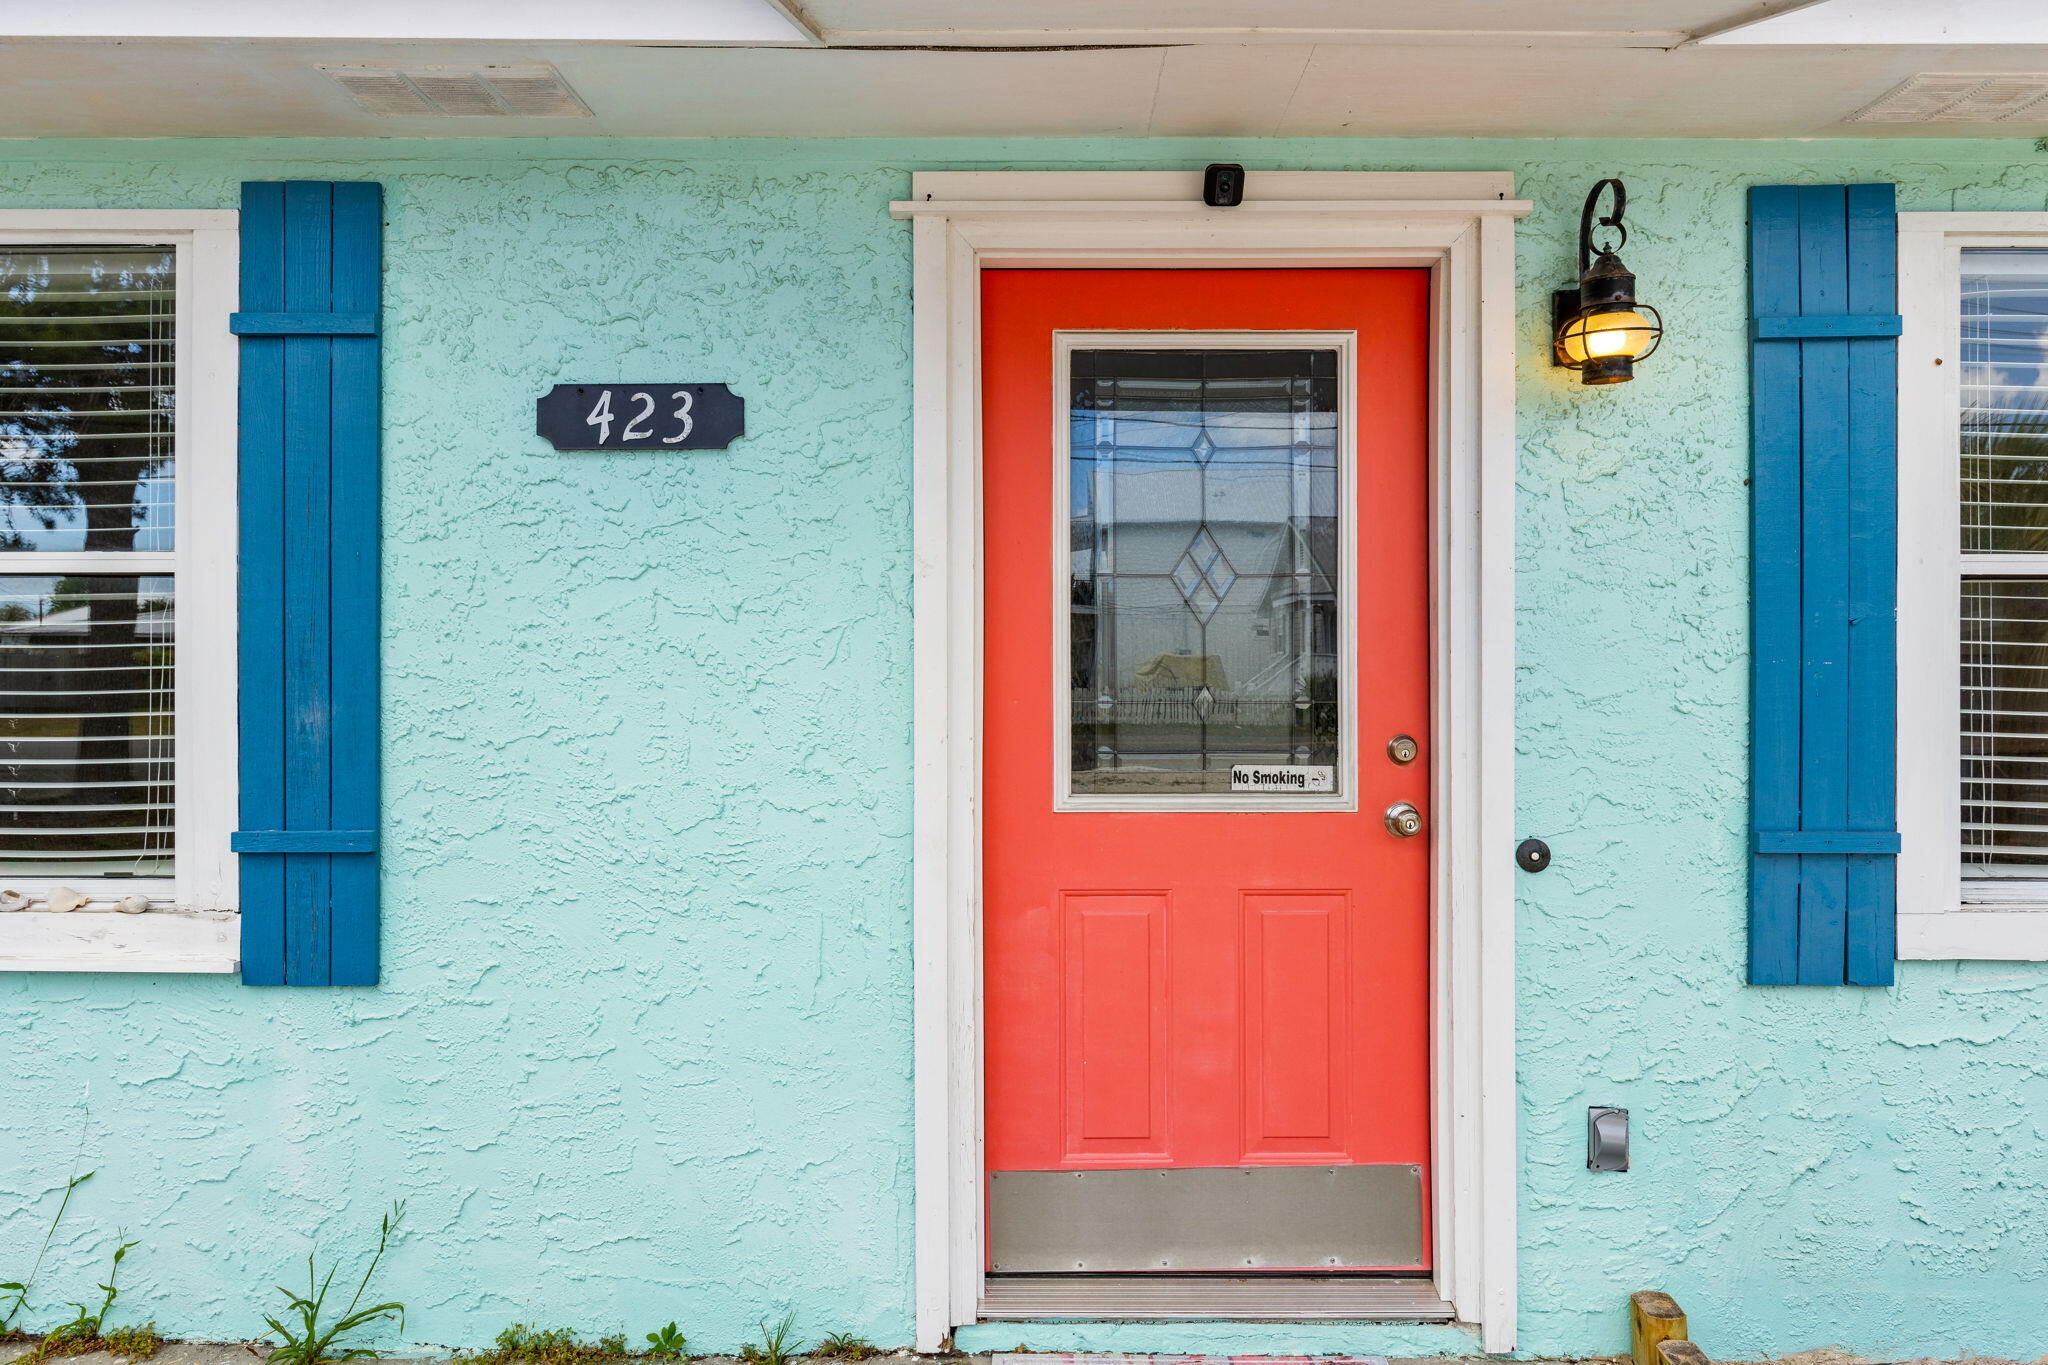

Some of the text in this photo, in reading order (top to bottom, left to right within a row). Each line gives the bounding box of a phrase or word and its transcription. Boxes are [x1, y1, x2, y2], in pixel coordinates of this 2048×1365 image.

[586, 390, 693, 445] 423
[1233, 770, 1305, 788] No Smoking
